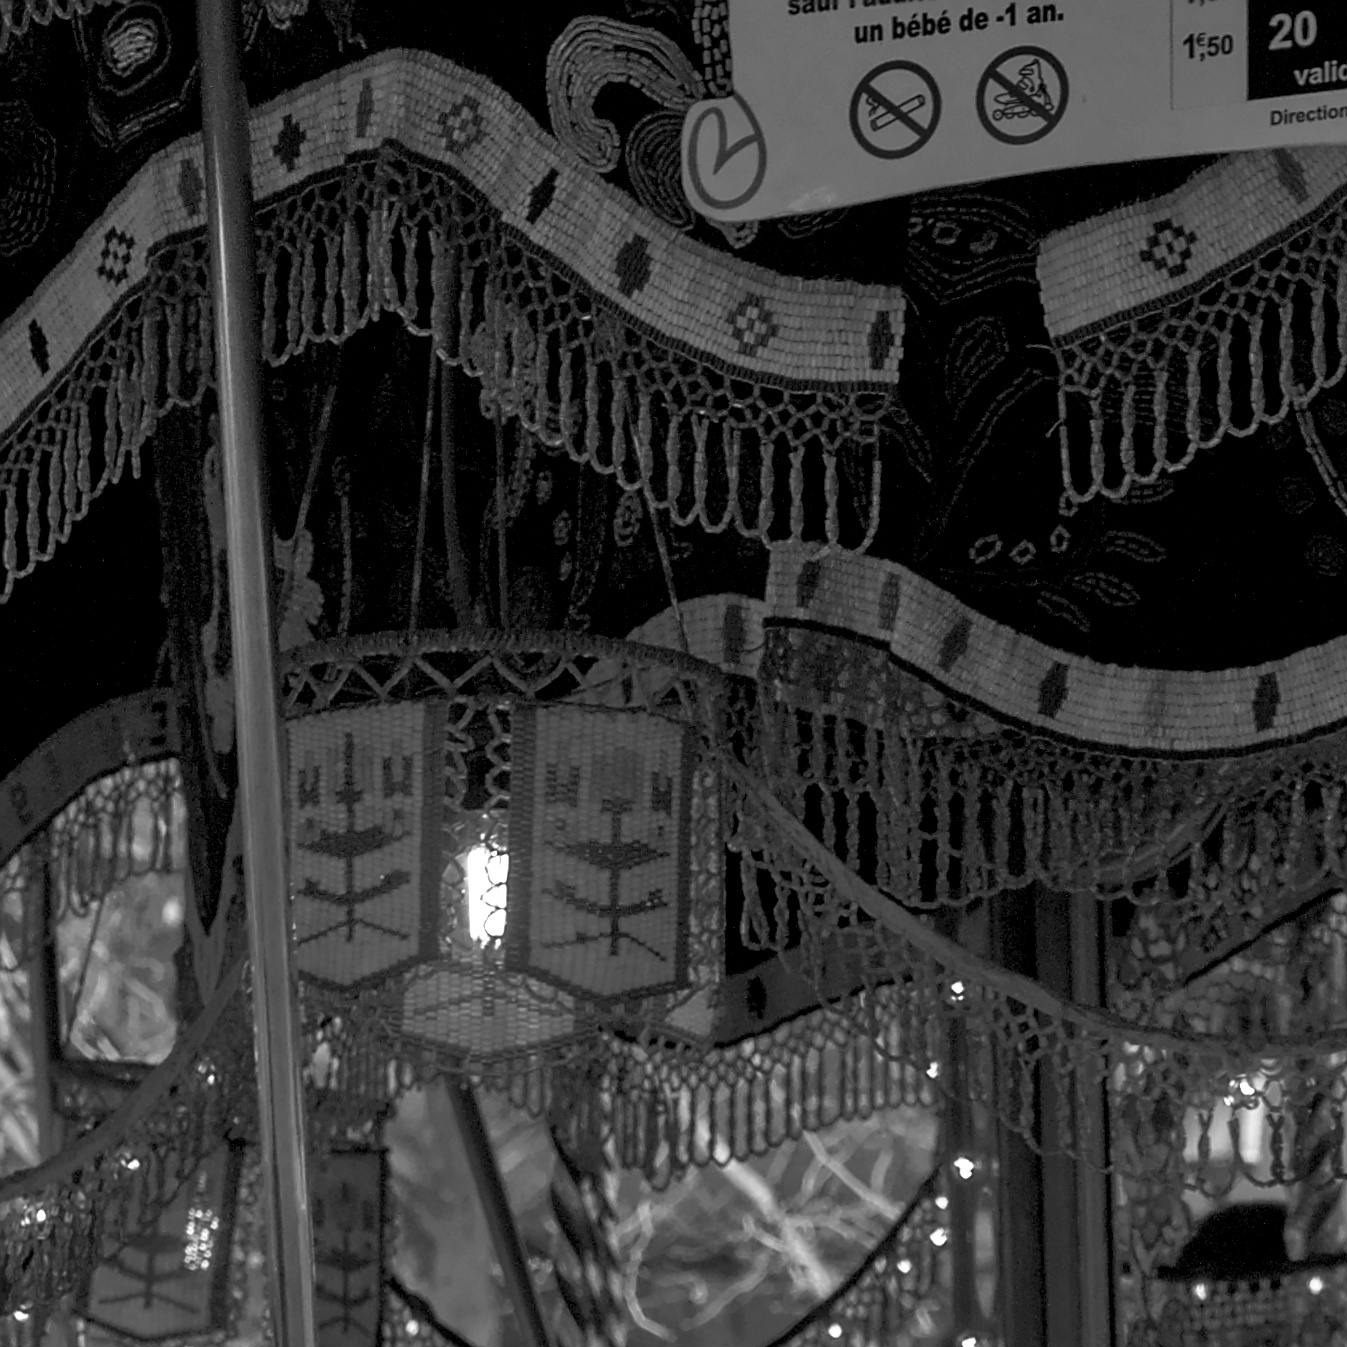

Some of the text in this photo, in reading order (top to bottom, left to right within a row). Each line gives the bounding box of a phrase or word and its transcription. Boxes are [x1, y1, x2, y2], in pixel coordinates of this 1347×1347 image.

[854, 23, 883, 43] un
[892, 9, 950, 39] bébé
[959, 8, 988, 31] de
[1027, 4, 1064, 25] an.
[1268, 10, 1318, 50] 20
